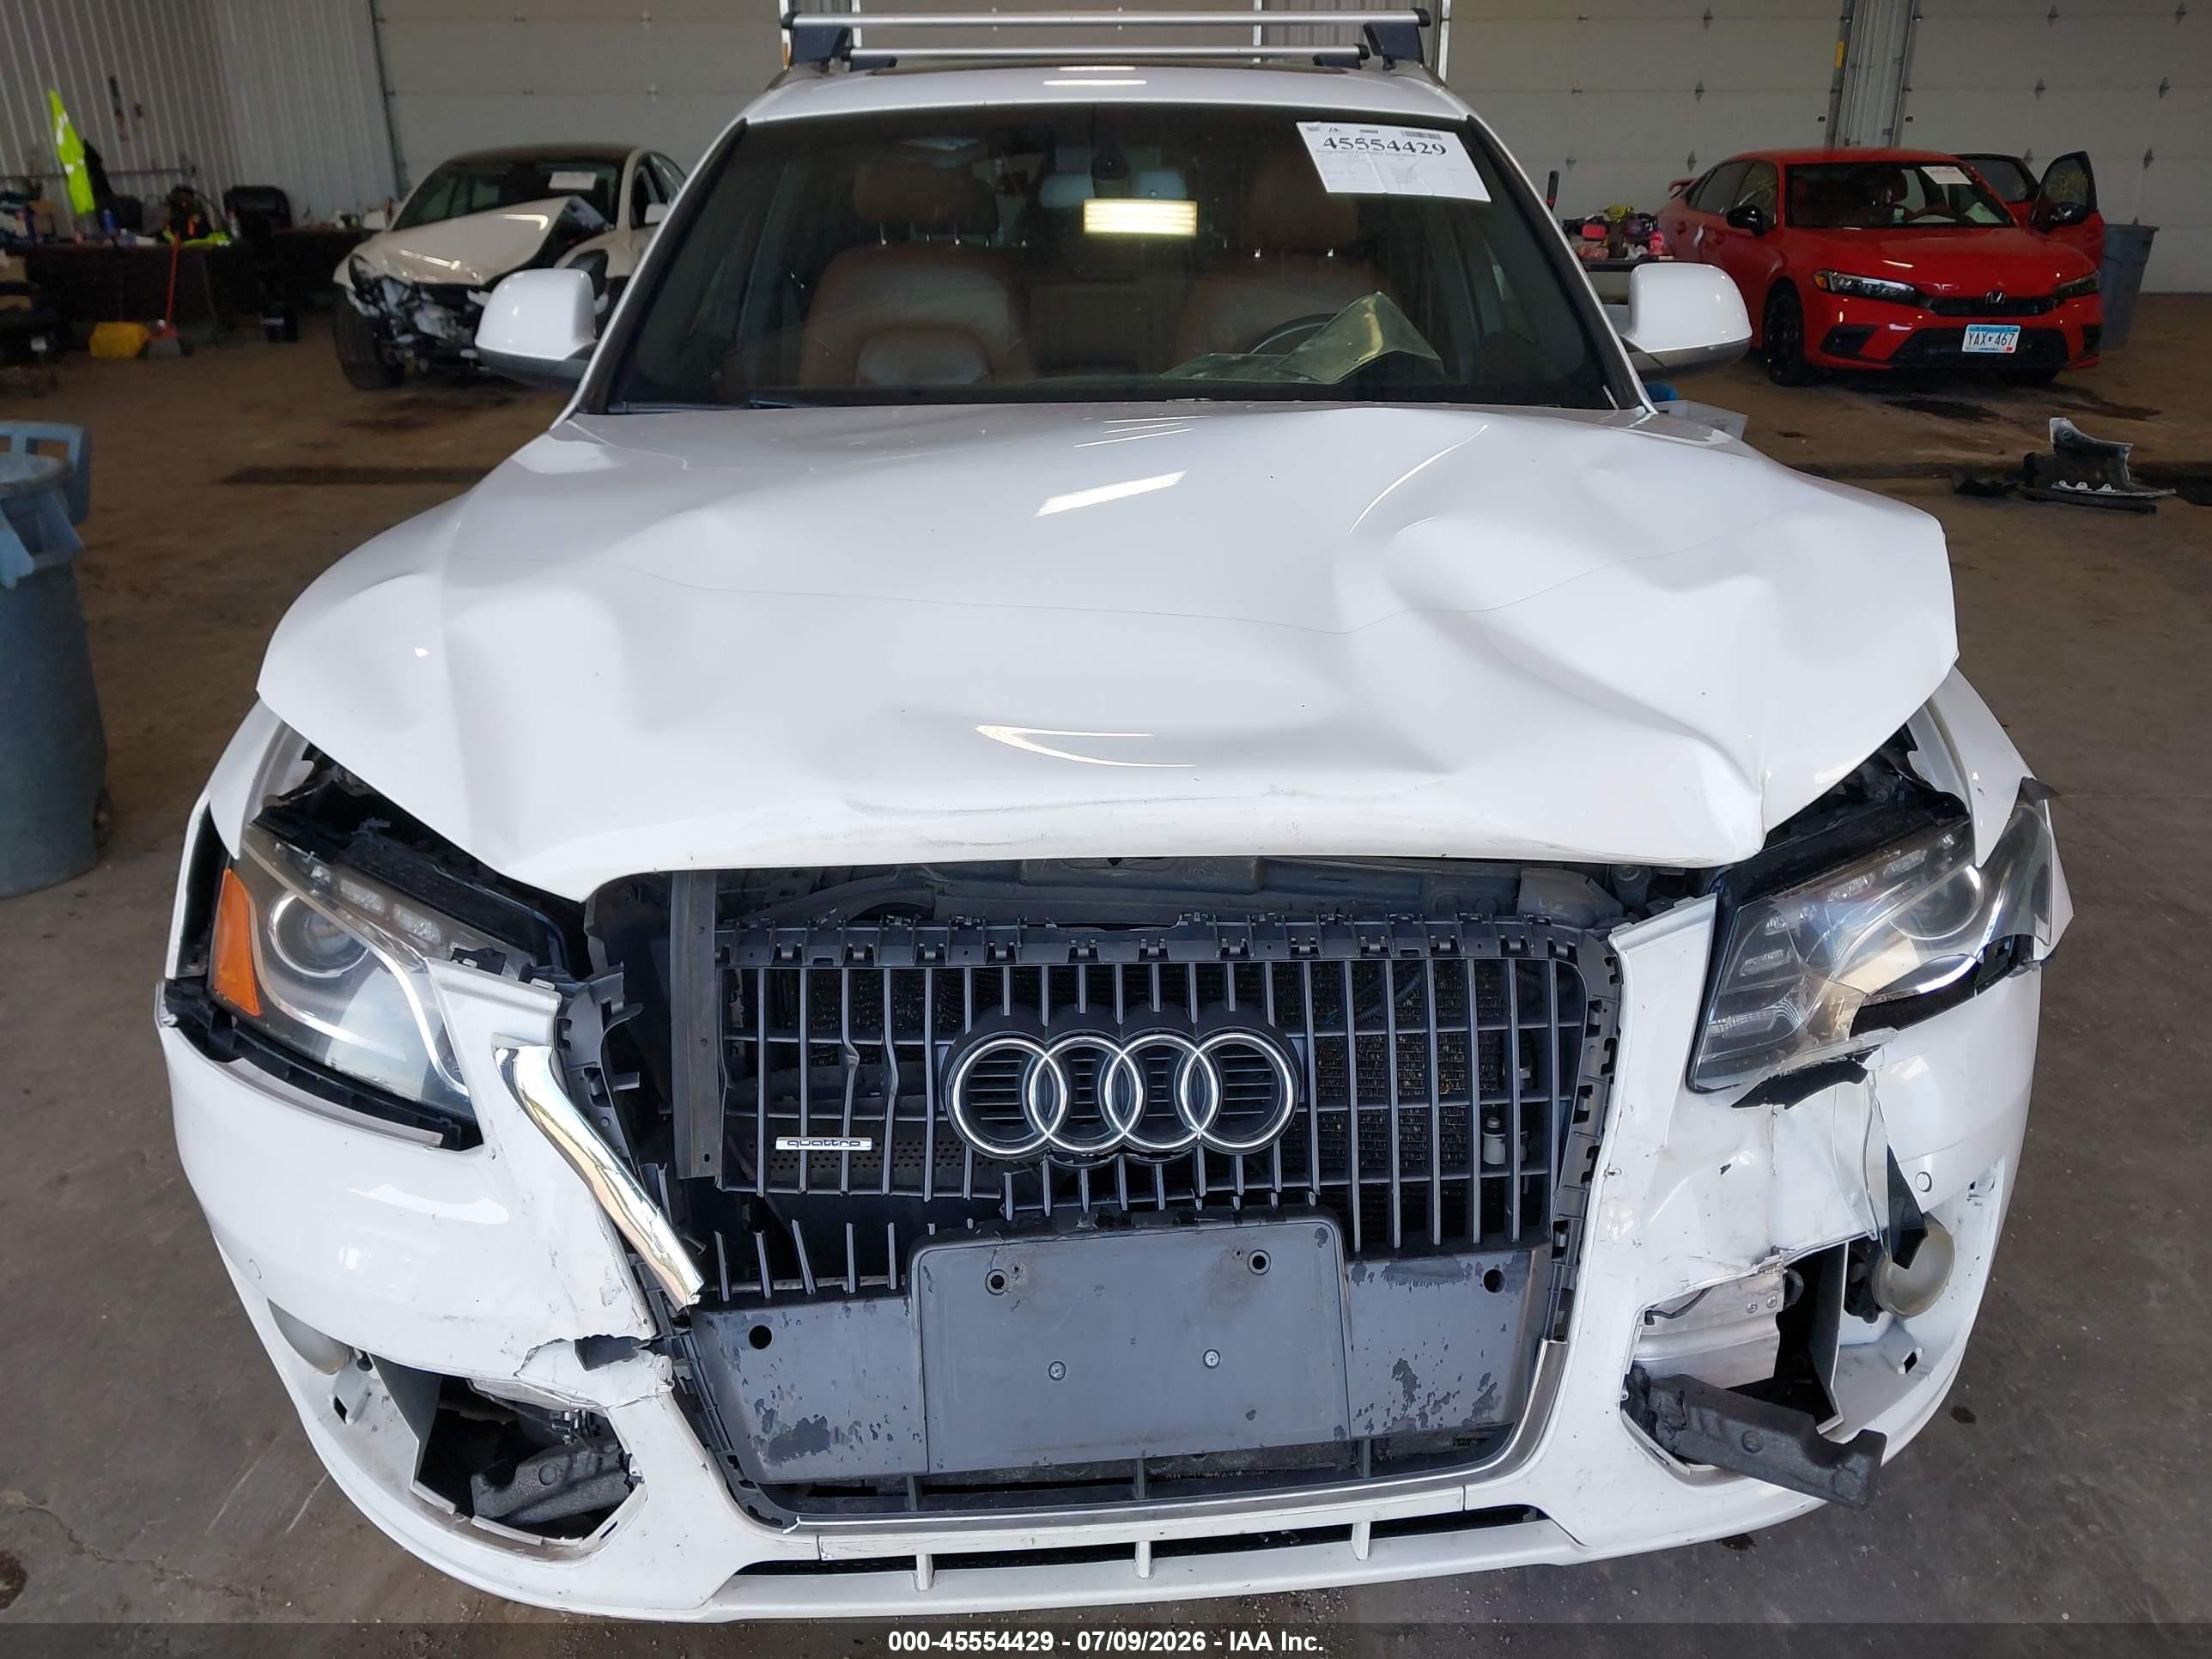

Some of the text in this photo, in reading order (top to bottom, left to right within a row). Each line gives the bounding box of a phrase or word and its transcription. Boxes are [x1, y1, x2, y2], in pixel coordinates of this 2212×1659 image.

[1323, 137, 1447, 155] 45554429
[1967, 332, 2015, 346] YAX 467
[787, 1139, 861, 1148] quattro
